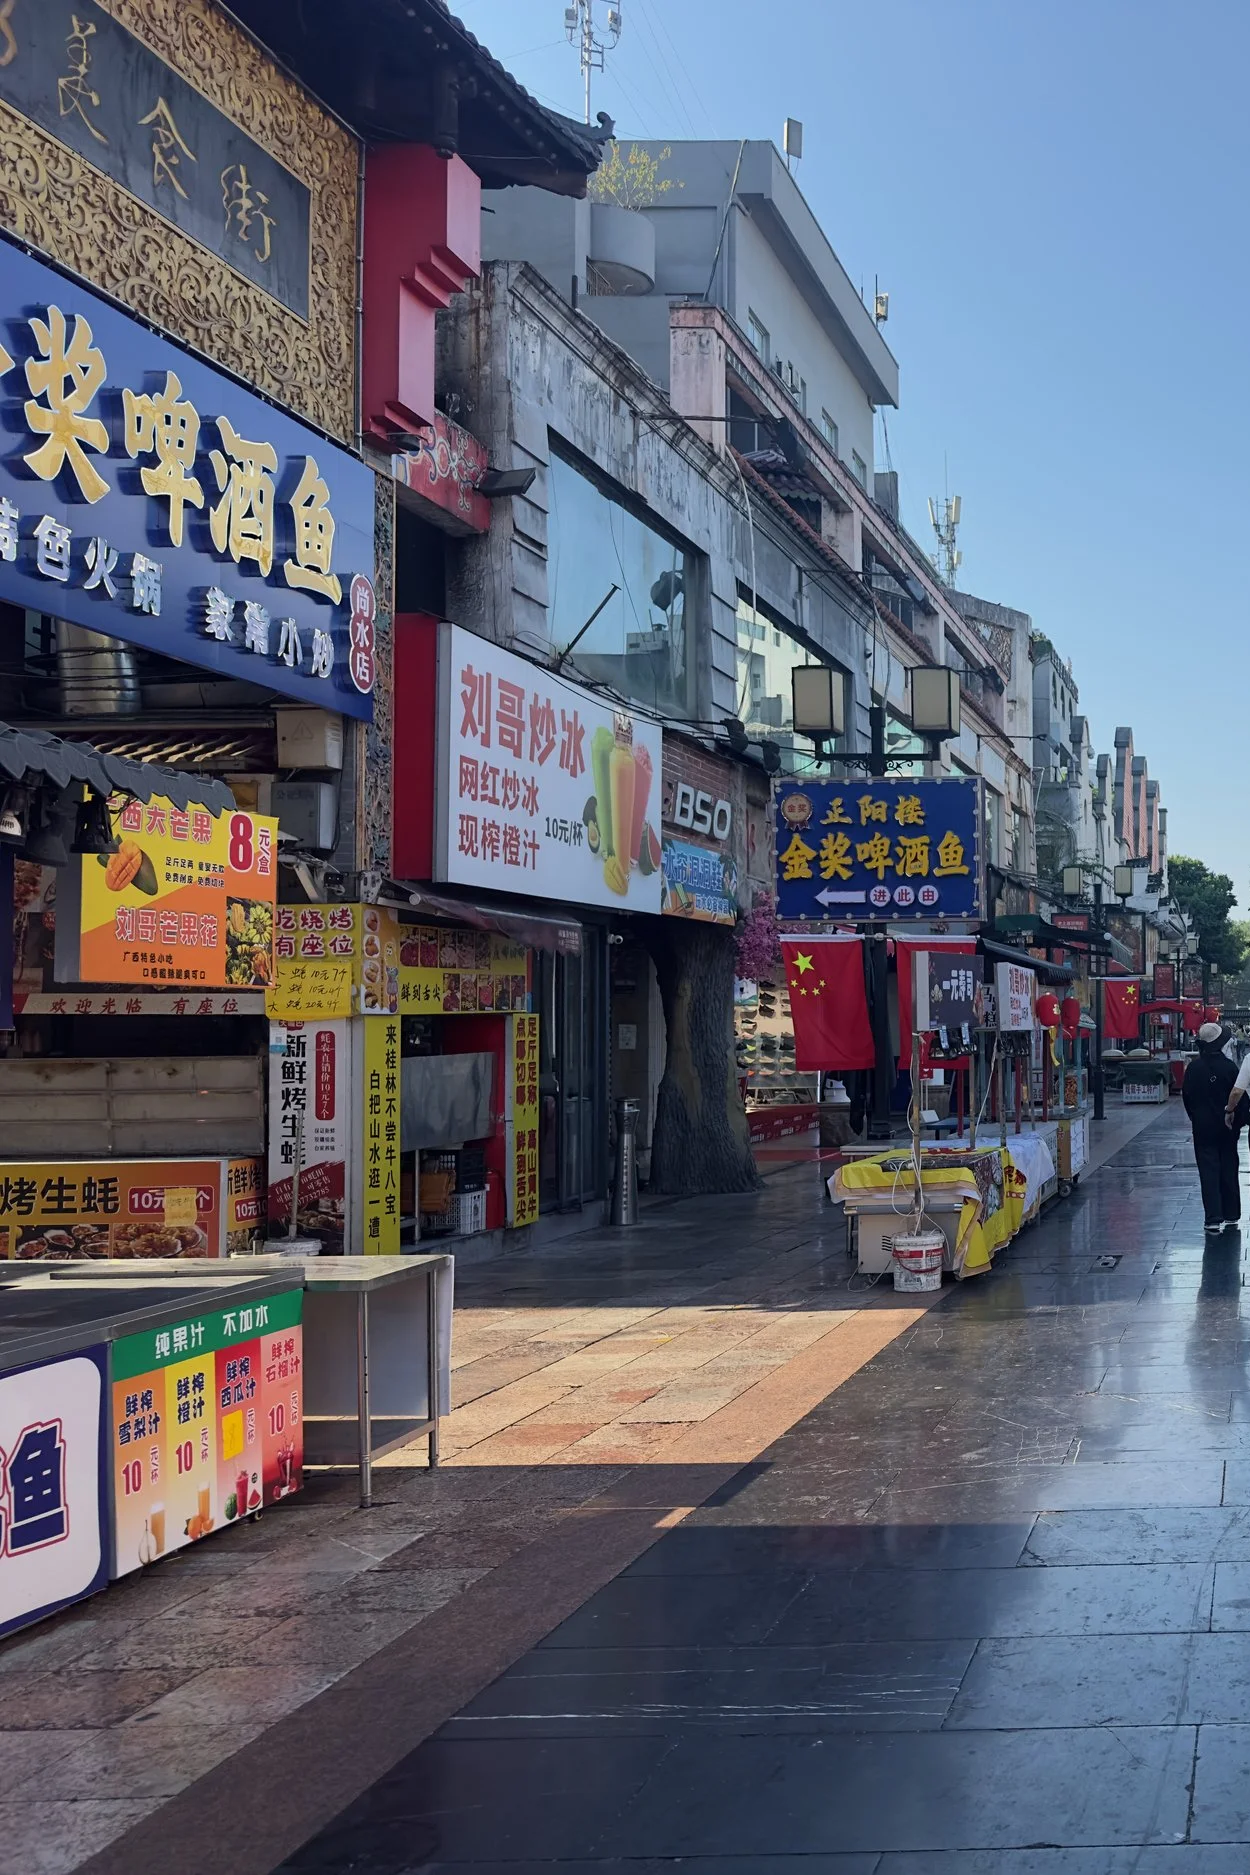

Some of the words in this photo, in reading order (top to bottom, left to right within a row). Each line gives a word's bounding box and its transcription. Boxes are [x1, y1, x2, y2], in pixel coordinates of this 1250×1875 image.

[0, 0, 277, 263] 美食街
[0, 304, 342, 605] 奖啤酒鱼
[355, 586, 372, 684] 尚水店
[460, 663, 587, 780] 刘哥炒冰
[458, 755, 540, 817] 网红炒冰
[106, 797, 213, 844] 西大芒果
[674, 781, 732, 841] BSO
[820, 795, 926, 826] 正阳楼
[229, 813, 254, 871] 8
[258, 829, 271, 874] 元/盒
[458, 813, 540, 871] 现榨橙汁
[545, 816, 583, 849] 10元/杯
[779, 831, 970, 881] 金奖啤酒鱼
[116, 907, 218, 946] 刘哥芒果花
[276, 908, 352, 930] 吃烧烤
[123, 951, 173, 964] 广西特色小吃
[275, 934, 352, 956] 有座位
[51, 998, 142, 1014] 欢迎光临
[171, 997, 239, 1014] 有座位
[281, 1034, 306, 1165] 新鲜烤生蚝
[155, 1322, 205, 1359] 纯果汁
[223, 1305, 269, 1336] 不加水
[271, 1337, 295, 1360] 鲜榨
[177, 1372, 205, 1400] 鲜榨
[226, 1357, 250, 1383] 鲜榨
[266, 1355, 301, 1384] 石榴汁
[125, 1390, 153, 1418] 鲜榨
[178, 1397, 205, 1424] 橙汁
[221, 1377, 256, 1408] 西瓜汁
[119, 1412, 160, 1445] 雪梨汁
[247, 1408, 255, 1444] 元/杯
[269, 1404, 284, 1435] 10
[176, 1441, 193, 1474] 10
[201, 1427, 209, 1463] 元/杯
[0, 1418, 69, 1557] 鱼
[122, 1461, 142, 1495] 10
[150, 1446, 159, 1483] 元/杯
